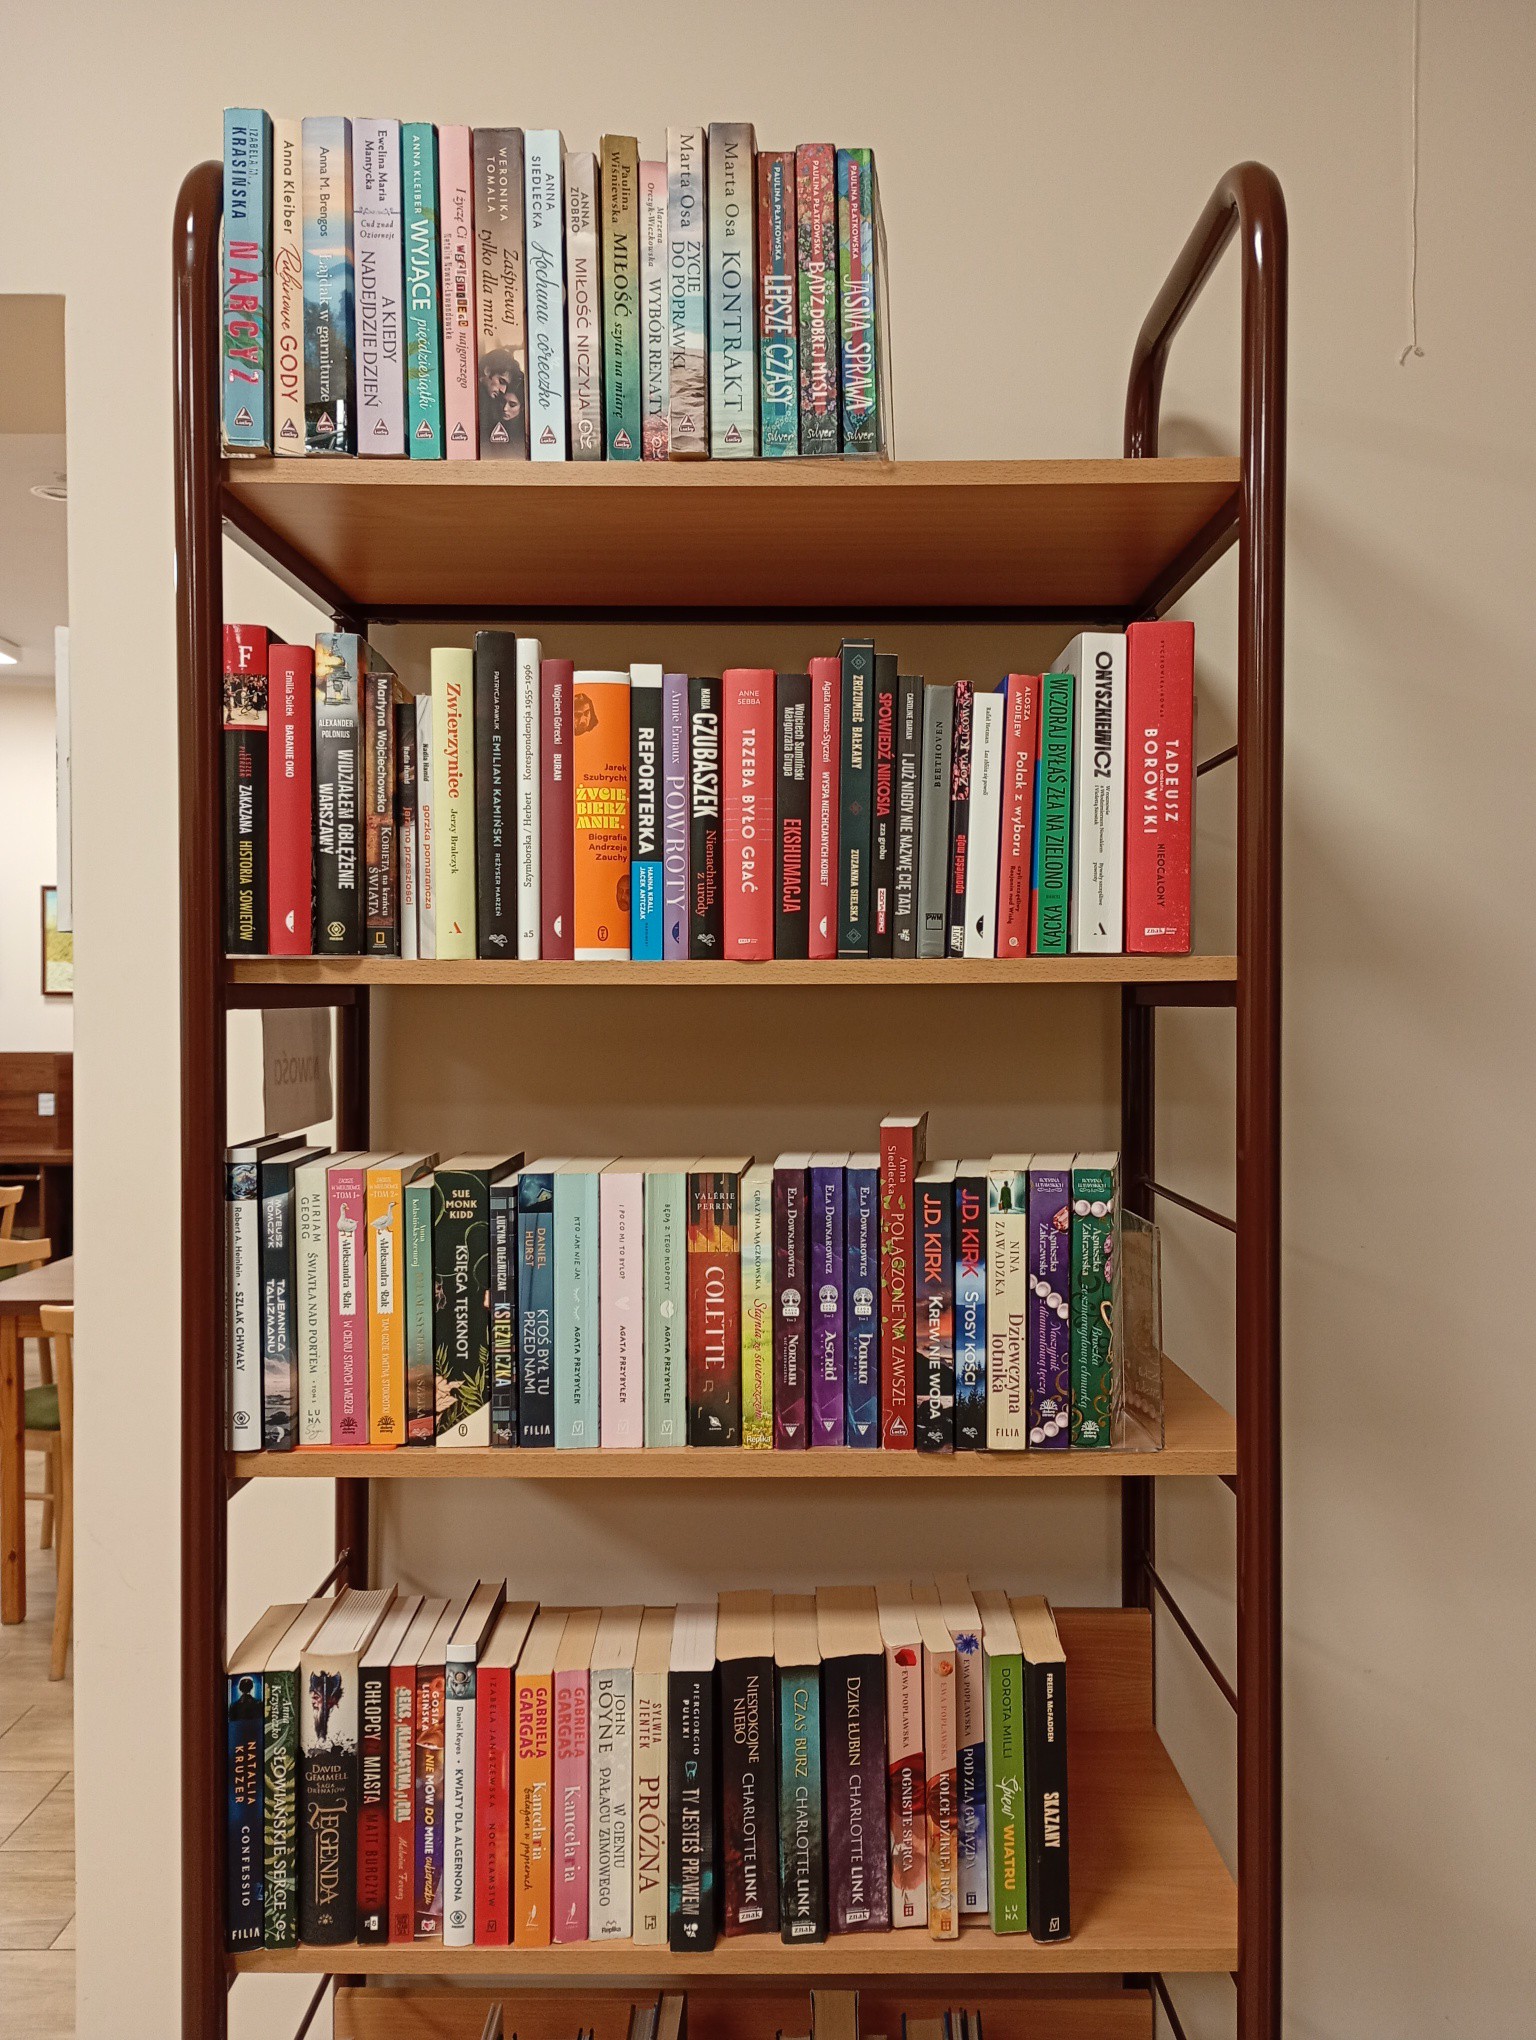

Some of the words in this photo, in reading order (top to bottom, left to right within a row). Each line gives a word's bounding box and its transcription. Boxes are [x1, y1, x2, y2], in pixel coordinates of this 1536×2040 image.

[284, 140, 294, 176] Anna
[365, 140, 375, 190] Mantycka
[377, 130, 387, 169] Ewelina
[412, 135, 421, 166] ANNA
[679, 134, 694, 187] Marta
[725, 142, 739, 196] Marta
[231, 126, 251, 219] KRASIŃSKA
[378, 172, 388, 201] Maria
[413, 170, 422, 214] KLEIBER
[486, 157, 497, 214] TOMALA
[499, 146, 509, 222] WERONIKA
[531, 155, 544, 229] SIEDLECKA
[545, 174, 556, 211] ANNA
[621, 165, 631, 211] Paulina
[284, 180, 295, 234] Kleiber
[571, 186, 582, 234] ZIOBRO
[581, 192, 591, 227] ANNA
[680, 194, 695, 228] Osa
[725, 204, 740, 237] Osa
[481, 229, 497, 266] tylko
[774, 204, 782, 261] PŁATKOWSKA
[360, 250, 376, 348] NADEJDZIE
[483, 270, 497, 294] dla
[503, 248, 519, 326] Zaśpiewaj
[575, 258, 592, 329] MIŁOŚĆ
[763, 274, 793, 334] LEPSZE
[483, 298, 496, 337] mnie
[648, 278, 665, 345] WYBÓR
[722, 251, 743, 412] KONTRAKT
[363, 352, 382, 408] DZIEŃ
[577, 335, 591, 411] NICZYJA
[649, 349, 666, 419] RENATY
[765, 343, 793, 407] CZASY
[285, 670, 295, 693] Emilia
[552, 684, 562, 715] Wojciech
[1023, 686, 1031, 720] ALOSZA
[285, 695, 295, 717] Sułek
[1012, 692, 1022, 738] AWDIEJEW
[285, 725, 295, 760] BARANIE
[422, 744, 430, 761] Nadia
[552, 717, 563, 744] Górecki
[285, 761, 295, 778] OKO
[422, 763, 430, 782] Hamid
[553, 754, 562, 780] BURAN
[741, 728, 756, 788] TRZEBA
[934, 721, 943, 787] BEETHOVEN
[638, 728, 654, 854] REPORTERKA
[1143, 728, 1157, 834] BOROWSKI
[1164, 740, 1179, 822] TADEUSZ
[319, 783, 334, 855] WARSZAWY
[423, 805, 431, 841] gorzka
[741, 795, 756, 839] BYŁO
[380, 826, 392, 872] KOBIETA
[596, 854, 627, 862] Zauchy
[741, 846, 758, 893] GRAĆ
[783, 819, 802, 912] EKSHUMACJA
[850, 850, 859, 886] ZUZANNA
[382, 875, 390, 885] na
[424, 844, 433, 910] pomarańcza
[1156, 844, 1165, 907] NIEOCALONY
[381, 887, 391, 916] krańcu
[696, 882, 707, 917] urody
[850, 888, 859, 922] SIELSKA
[888, 1145, 897, 1195] Siedlecka
[899, 1157, 907, 1183] Anna
[446, 1200, 478, 1208] MONK
[450, 1210, 474, 1219] KIDD
[452, 1190, 470, 1198] SUE
[234, 1207, 242, 1233] Robert
[235, 1234, 242, 1244] A.
[301, 1197, 310, 1240] GEORG
[312, 1194, 321, 1242] MIRIAM
[342, 1239, 352, 1287] Aleksandra
[525, 1231, 534, 1266] HURST
[537, 1228, 546, 1269] DANIEL
[995, 1222, 1005, 1296] ZAWADZKA
[1010, 1241, 1020, 1272] NINA
[1040, 1224, 1049, 1276] Zakrzewska
[1082, 1224, 1091, 1276] Zakrzewska
[236, 1292, 244, 1324] SZLAK
[266, 1279, 276, 1353] TALIZMANU
[278, 1279, 286, 1352] TAJEMNICA
[342, 1290, 352, 1308] Rak
[705, 1266, 726, 1370] COLETTE
[236, 1327, 245, 1371] CHWAŁY
[524, 1311, 534, 1354] PRZED
[524, 1358, 536, 1394] NAMI
[992, 1333, 1006, 1394] lotnika
[1004, 1313, 1024, 1414] Dziewczyna
[996, 1428, 1020, 1437] FILIA
[282, 1699, 292, 1724] Anna
[421, 1684, 430, 1732] LISIŃSKA
[430, 1691, 440, 1724] GOSIA
[598, 1680, 613, 1753] BOYNE
[613, 1694, 626, 1735] JOHN
[682, 1700, 690, 1738] PULIXI
[746, 1676, 759, 1763] NIESPOKOJNE
[847, 1677, 861, 1718] DZIKI
[519, 1687, 537, 1759] GARGAŚ
[535, 1687, 548, 1758] GABRIELA
[557, 1688, 576, 1760] GARGAŚ
[574, 1687, 585, 1758] GABRIELA
[639, 1700, 650, 1749] ZIENTEK
[652, 1703, 662, 1743] SYLWIA
[733, 1698, 746, 1744] NIEBO
[454, 1733, 463, 1755] Keyes
[848, 1723, 860, 1766] ŁUBIN
[235, 1746, 245, 1804] KRUZER
[247, 1741, 256, 1805] NATALIA
[305, 1773, 348, 1781] GEMMELL
[312, 1764, 341, 1773] DAVID
[454, 1769, 463, 1809] KWIATY
[454, 1812, 463, 1833] DLA
[613, 1803, 626, 1817] W
[742, 1773, 757, 1861] CHARLOTTE
[849, 1775, 863, 1862] CHARLOTTE
[563, 1786, 582, 1882] Kancelaria
[613, 1821, 625, 1868] CIENIU
[638, 1776, 665, 1894] PRÓŻNA
[241, 1826, 250, 1906] CONFESSIO
[453, 1836, 463, 1901] ALGERNONA
[744, 1865, 757, 1903] LINK
[851, 1866, 864, 1904] LINK
[232, 1930, 260, 1940] FILIA
